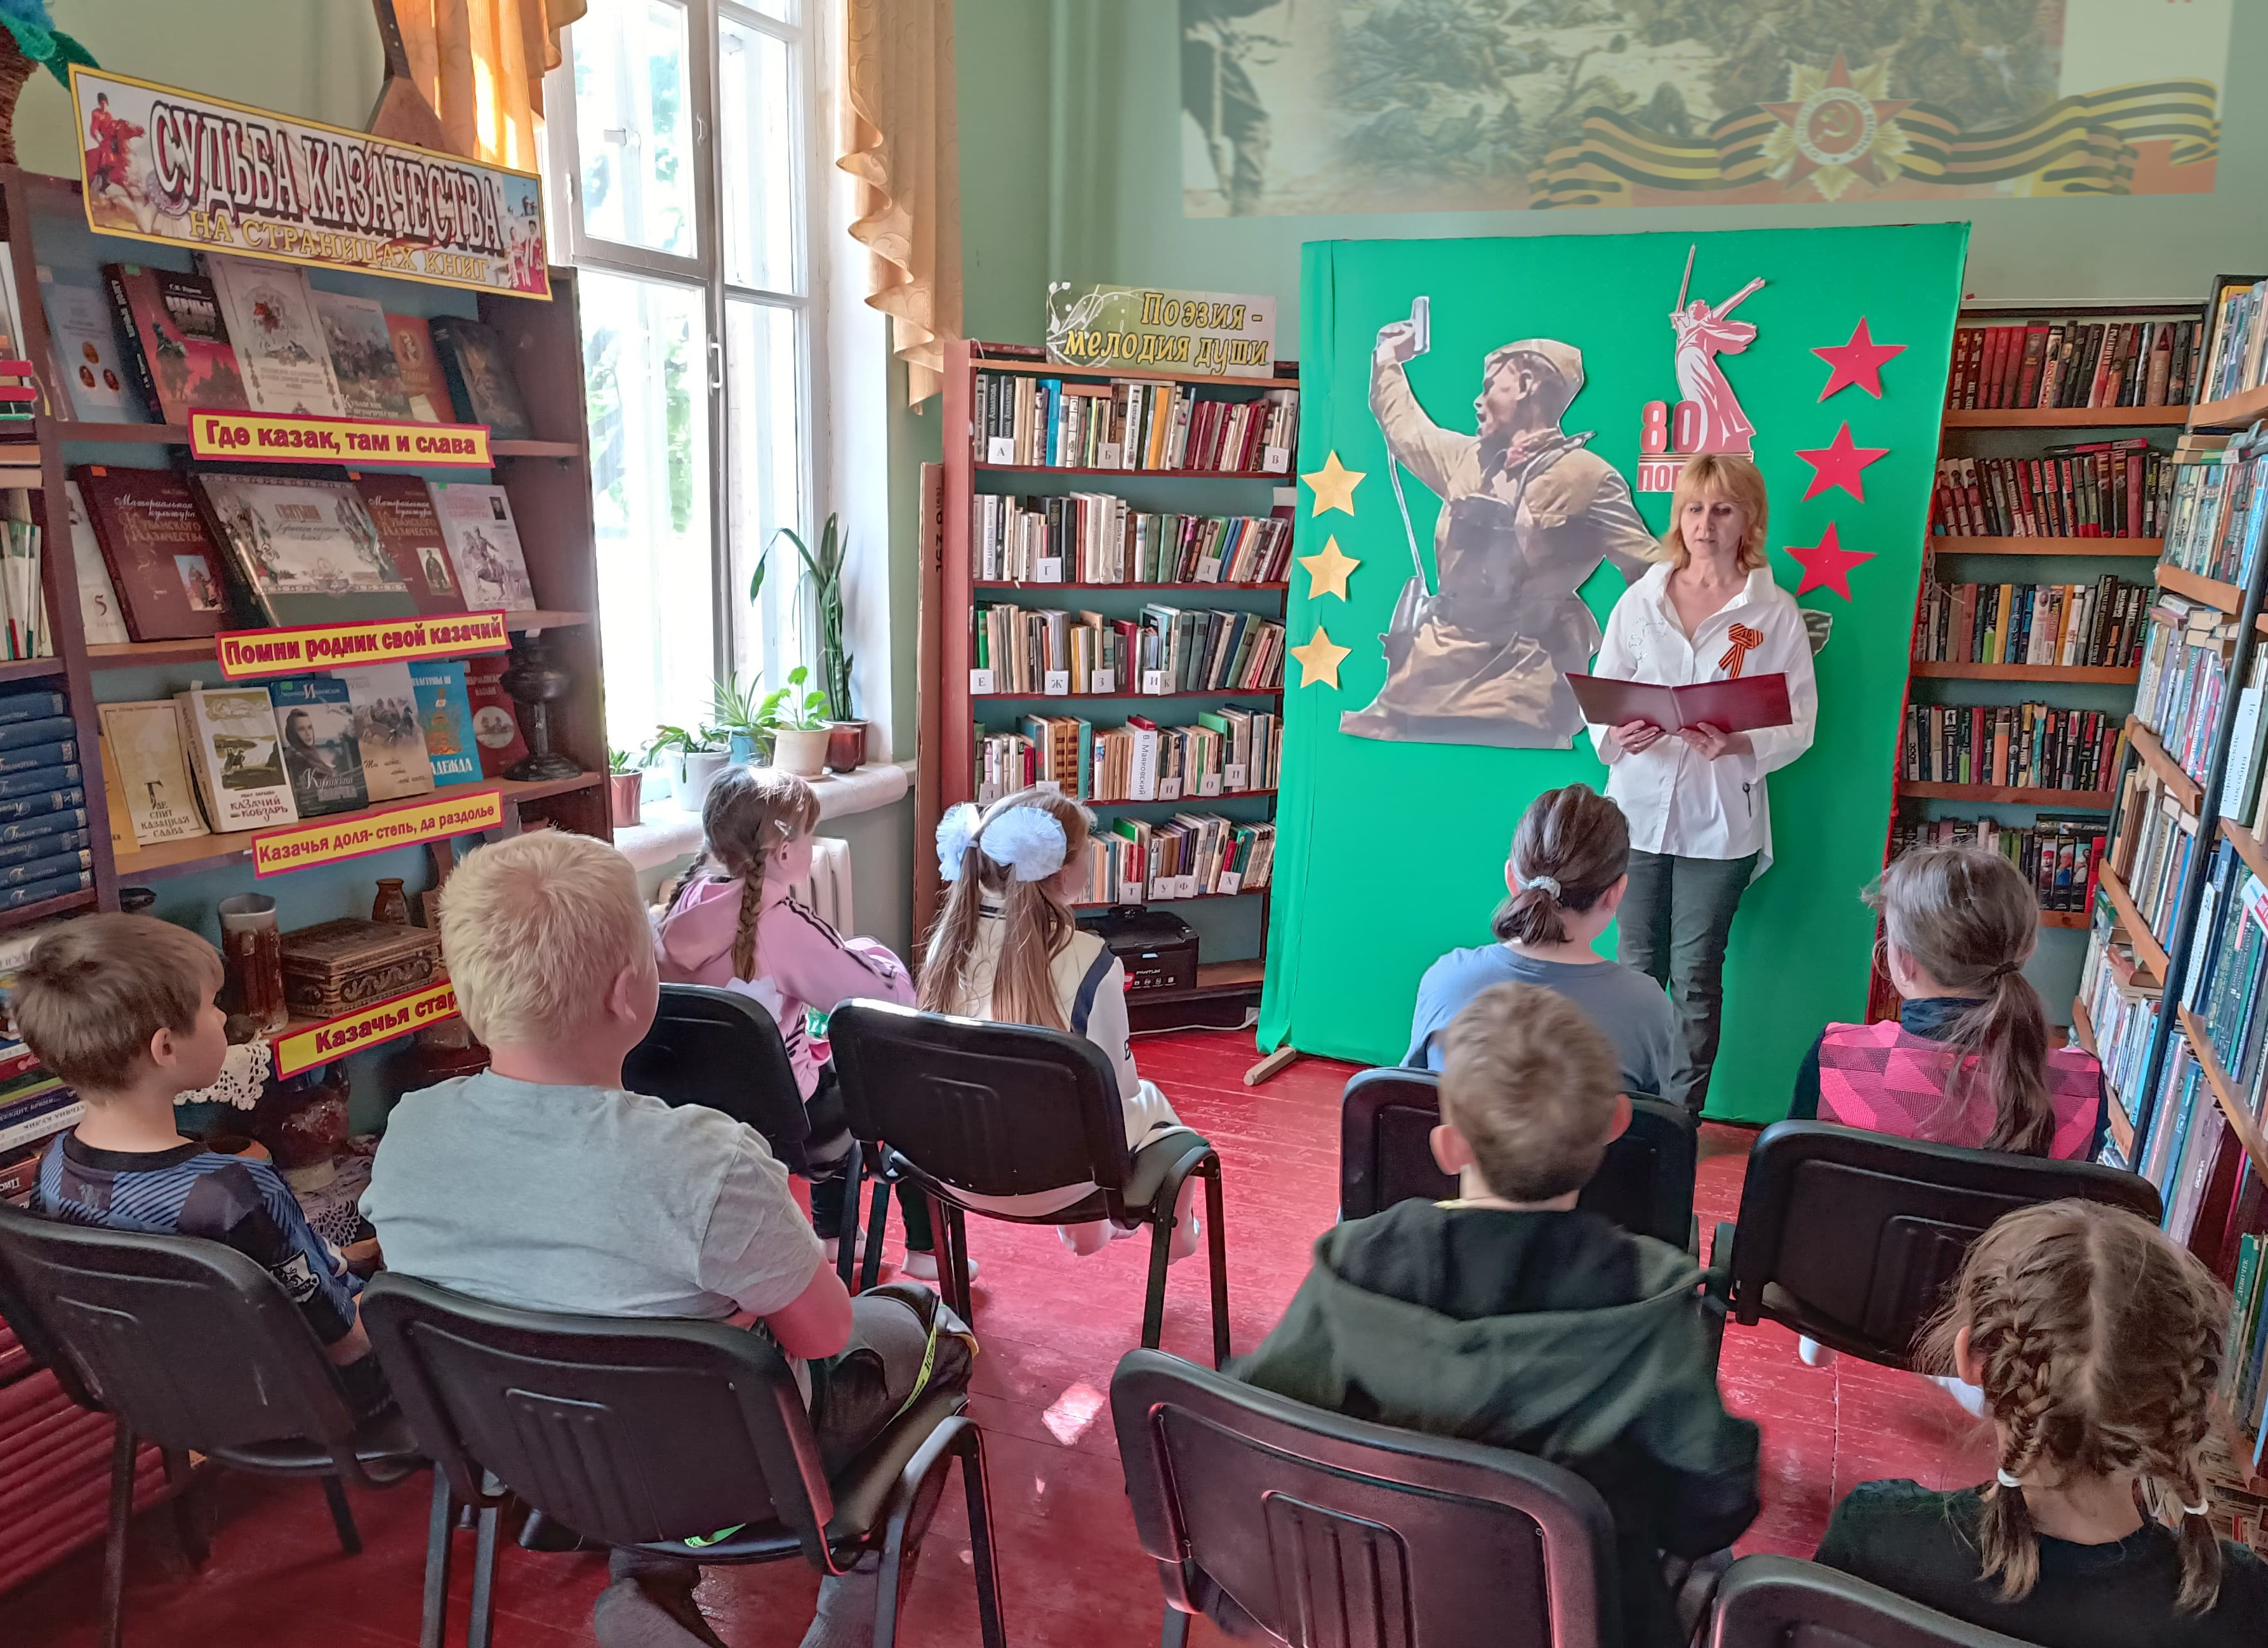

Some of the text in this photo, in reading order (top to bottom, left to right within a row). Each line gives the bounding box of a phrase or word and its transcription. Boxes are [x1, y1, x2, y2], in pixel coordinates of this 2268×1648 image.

[150, 100, 506, 254] СУДЬБА КАЗАЧЕСТВА
[189, 209, 491, 282] НА СТРАНИЦАХ КНИГ
[1141, 293, 1247, 330] Поэзия
[1063, 329, 1269, 376] мелодия души
[205, 419, 476, 455] Где казак, там и слава
[1640, 401, 1702, 453] 80
[996, 446, 1006, 458] А
[1271, 453, 1280, 464] В
[95, 594, 107, 616] 5
[224, 615, 503, 667] Помни родник свой казачий
[978, 676, 986, 688] Е
[1051, 678, 1064, 689] Ж
[1149, 675, 1159, 686] И
[1164, 678, 1170, 688] К
[430, 758, 473, 776] АДЕЖДА
[1137, 744, 1150, 796] Маяковский
[230, 795, 281, 811] КАЗАЧИЙ
[259, 835, 329, 864] Казачья
[376, 821, 418, 840] степь,
[420, 818, 436, 834] да
[439, 805, 495, 830] раздолье
[315, 1007, 410, 1054] Казачья
